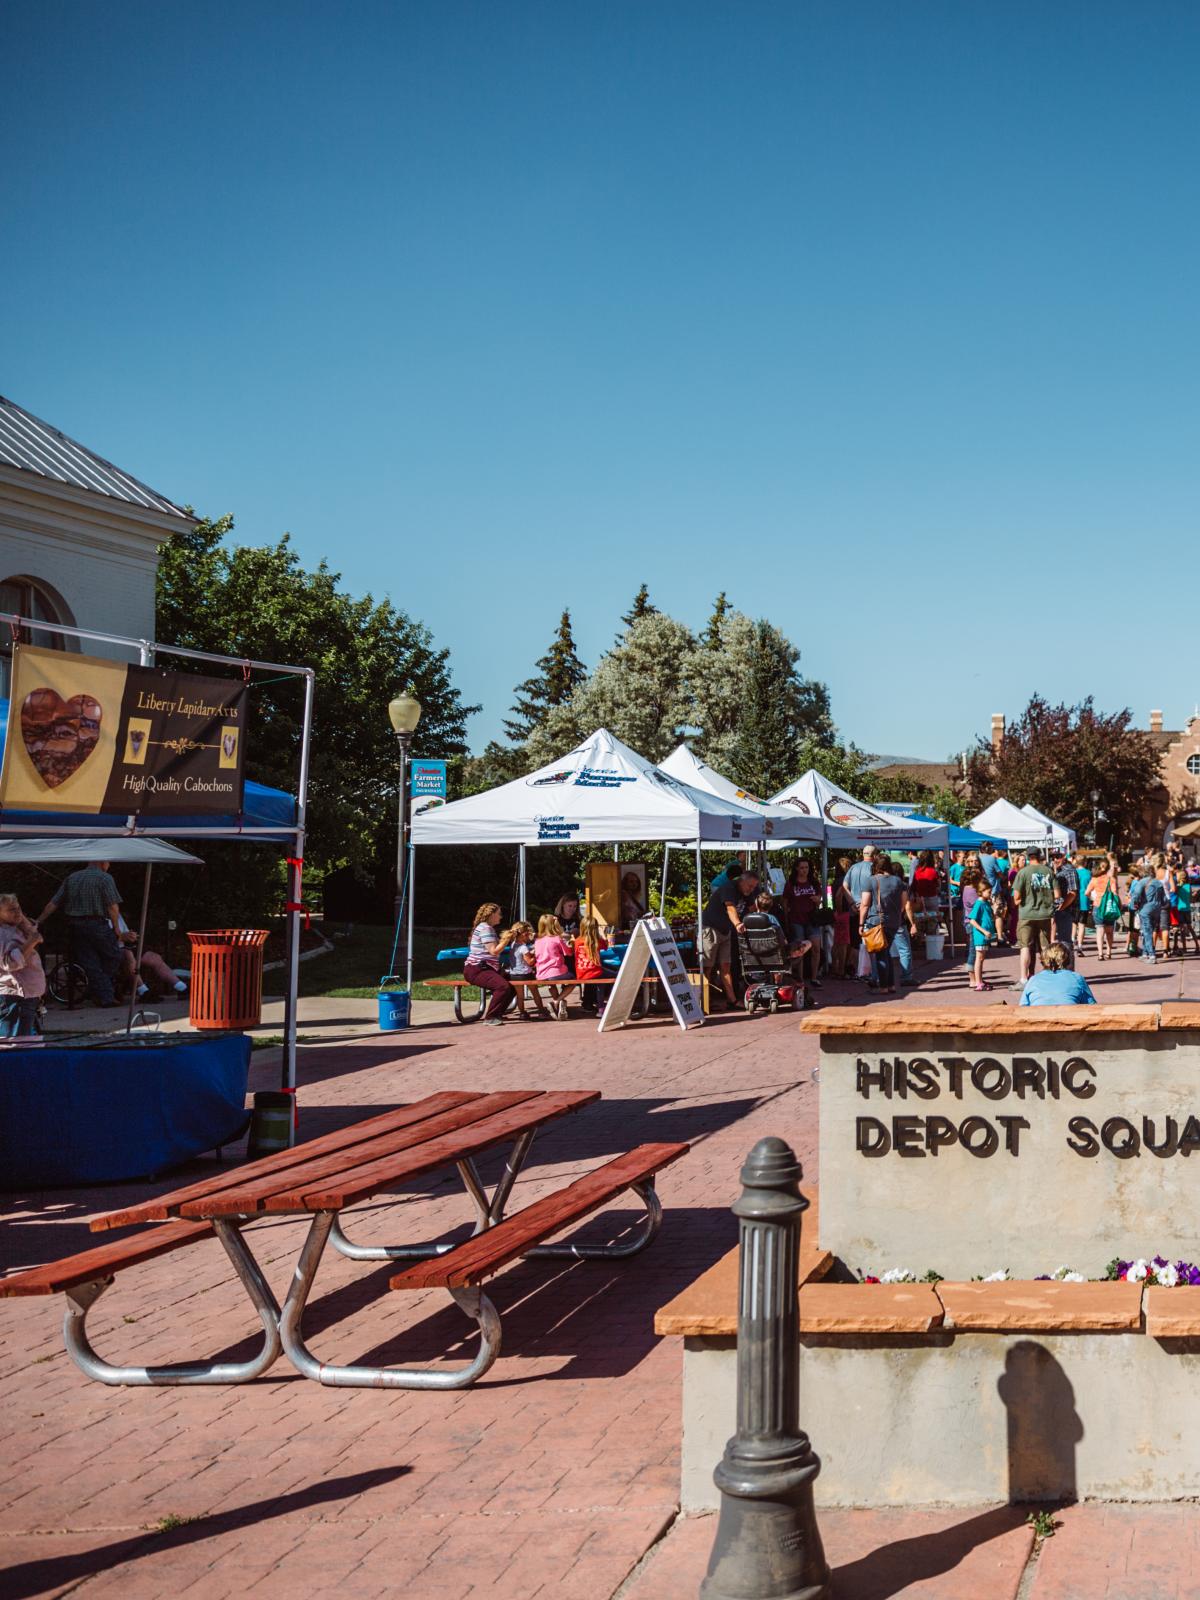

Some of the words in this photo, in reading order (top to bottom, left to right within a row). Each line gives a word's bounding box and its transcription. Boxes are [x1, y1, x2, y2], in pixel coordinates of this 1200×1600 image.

[137, 691, 177, 717] Liberty
[184, 776, 233, 793] Cabochons
[856, 1057, 1097, 1099] HISTORIC
[856, 1116, 1029, 1157] DEPOT
